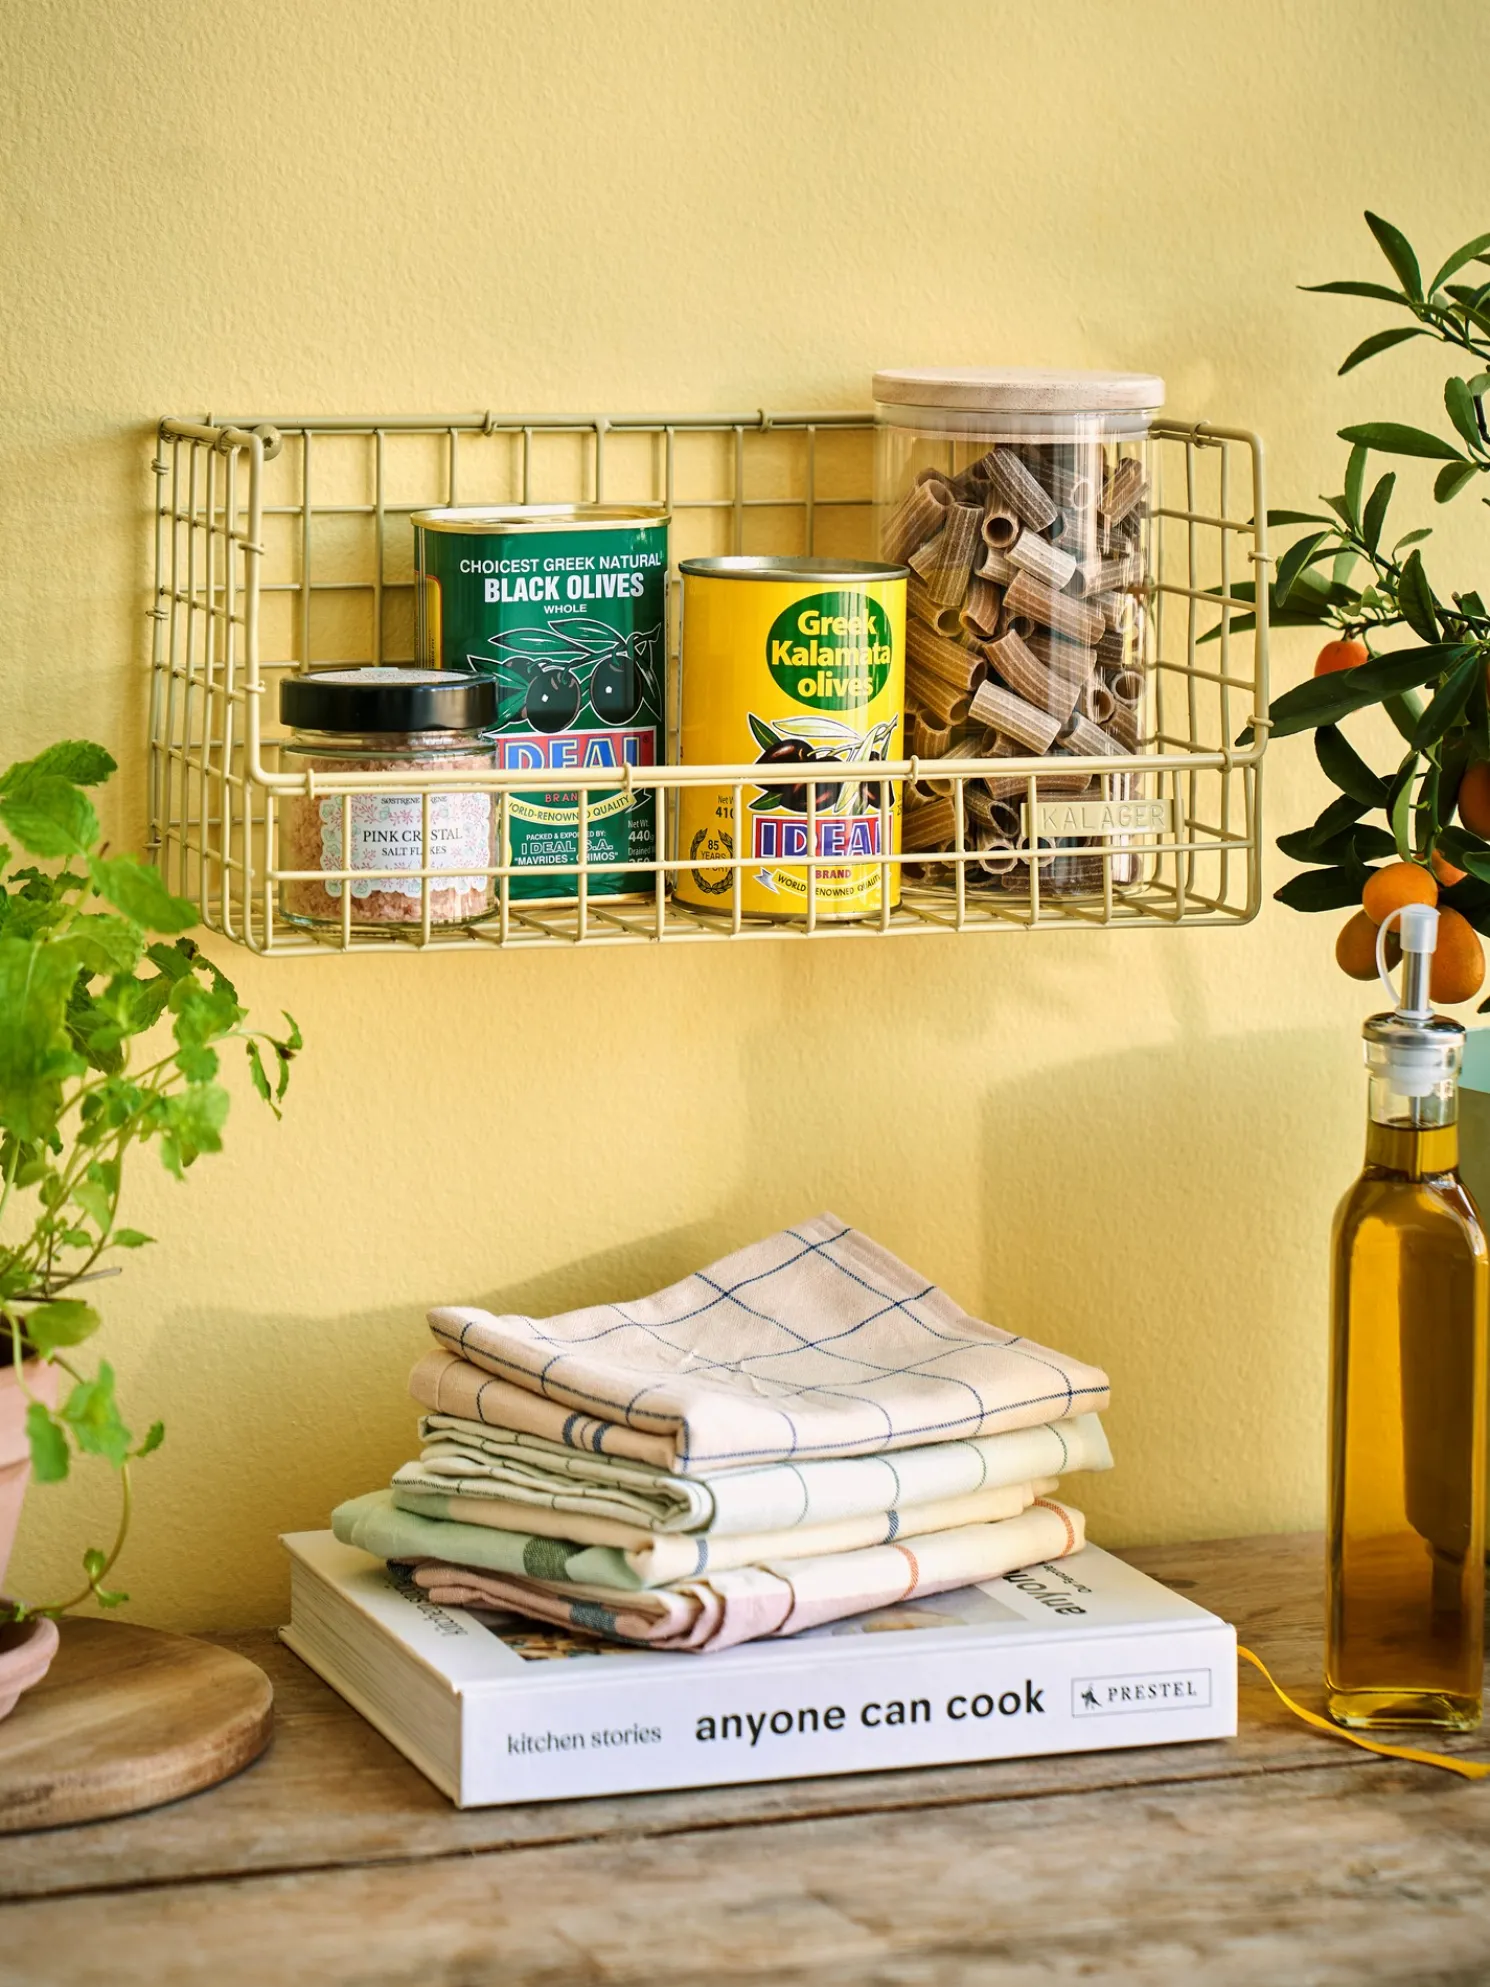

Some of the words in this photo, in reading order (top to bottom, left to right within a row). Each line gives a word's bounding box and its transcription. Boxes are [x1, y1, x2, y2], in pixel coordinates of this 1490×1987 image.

[459, 558, 539, 574] CHOICEST
[543, 555, 595, 572] GREEK
[599, 552, 661, 569] NATURAL
[484, 576, 559, 603] BLACK
[566, 572, 644, 599] OLIVES
[543, 603, 588, 614] WHOLE
[797, 609, 877, 636] Greek
[771, 640, 891, 667] Kalamata
[797, 671, 874, 697] olives
[545, 793, 578, 803] BRAN
[593, 795, 629, 816] QUALITY
[1042, 804, 1166, 831] KALAGER
[362, 830, 399, 843] PINK
[401, 828, 463, 842] CRSTAL
[526, 833, 553, 841] PACKED
[707, 839, 719, 850] 85
[381, 847, 408, 857] SALT
[410, 846, 447, 856] FLKES
[521, 841, 576, 855] IDEAL
[701, 850, 726, 860] YEARS
[777, 873, 807, 892] WORLD
[816, 887, 854, 896] ENOWNED
[816, 869, 851, 879] BRAND
[1107, 1680, 1198, 1702] PRESTEL
[695, 1704, 846, 1747] anyone
[860, 1698, 931, 1727] can
[946, 1679, 1046, 1721] cook
[507, 1731, 586, 1755] kitchen
[591, 1722, 662, 1748] stories
